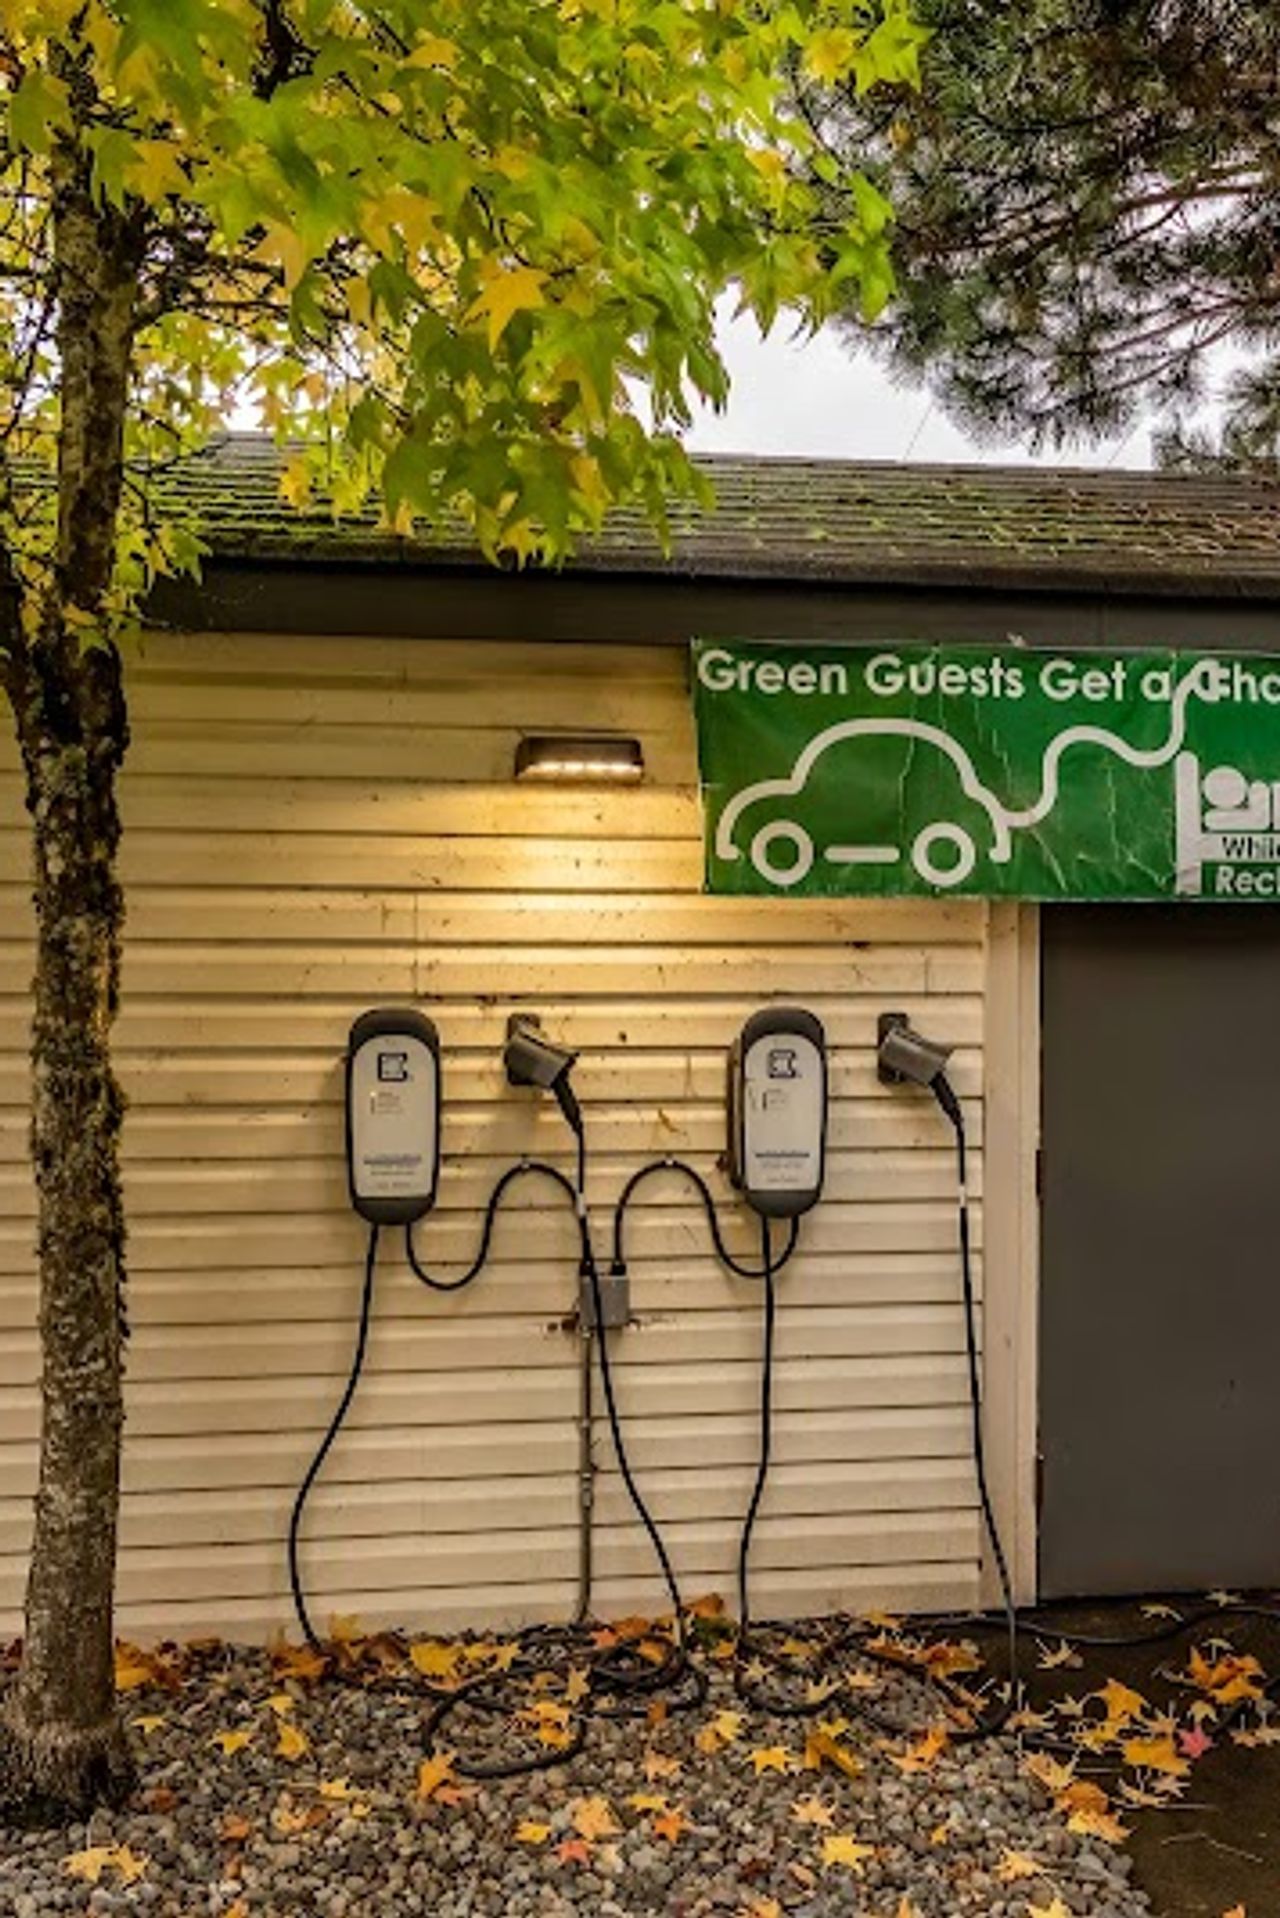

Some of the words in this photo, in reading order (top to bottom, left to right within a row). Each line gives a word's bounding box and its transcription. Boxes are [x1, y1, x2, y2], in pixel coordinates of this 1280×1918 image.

[698, 649, 847, 694] Green
[865, 653, 1026, 699] Guests
[1039, 658, 1127, 701] Get
[1140, 669, 1170, 701] a
